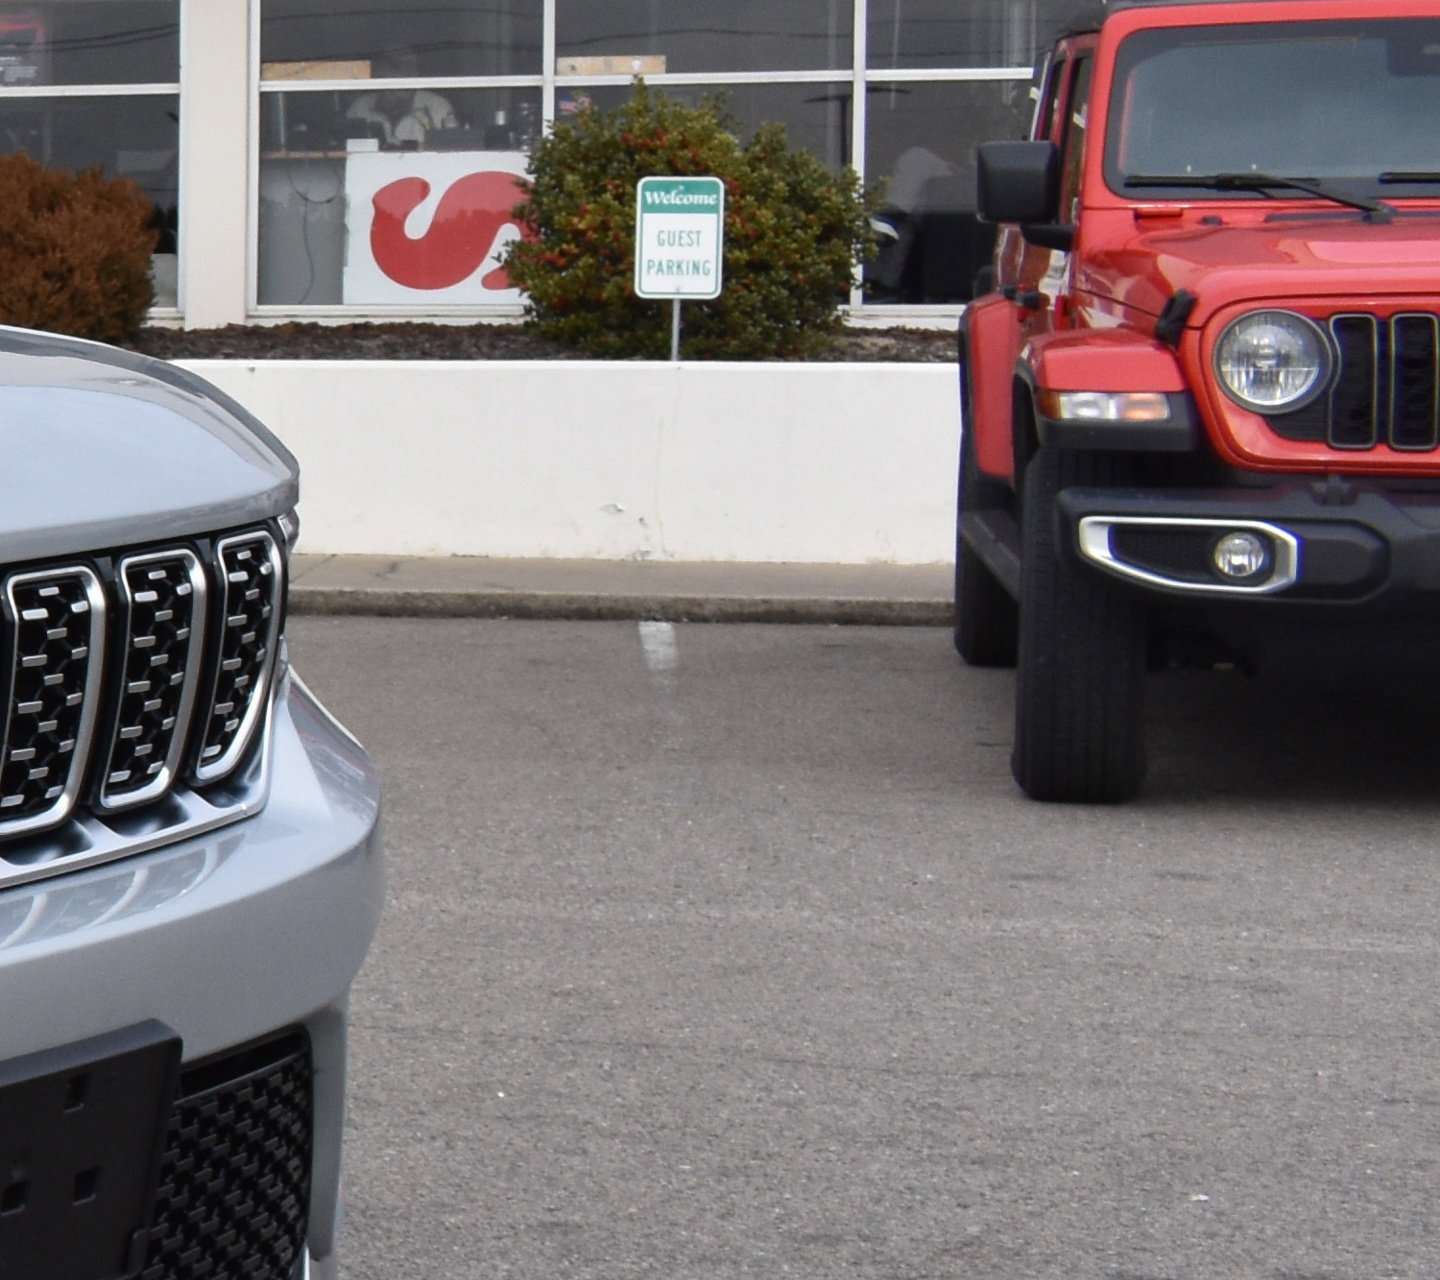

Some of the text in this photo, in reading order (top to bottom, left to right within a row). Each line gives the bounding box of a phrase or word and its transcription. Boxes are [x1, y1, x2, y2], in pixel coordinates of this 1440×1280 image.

[645, 187, 718, 206] Welcome
[656, 229, 702, 248] GUEST
[646, 259, 712, 277] PARKING
